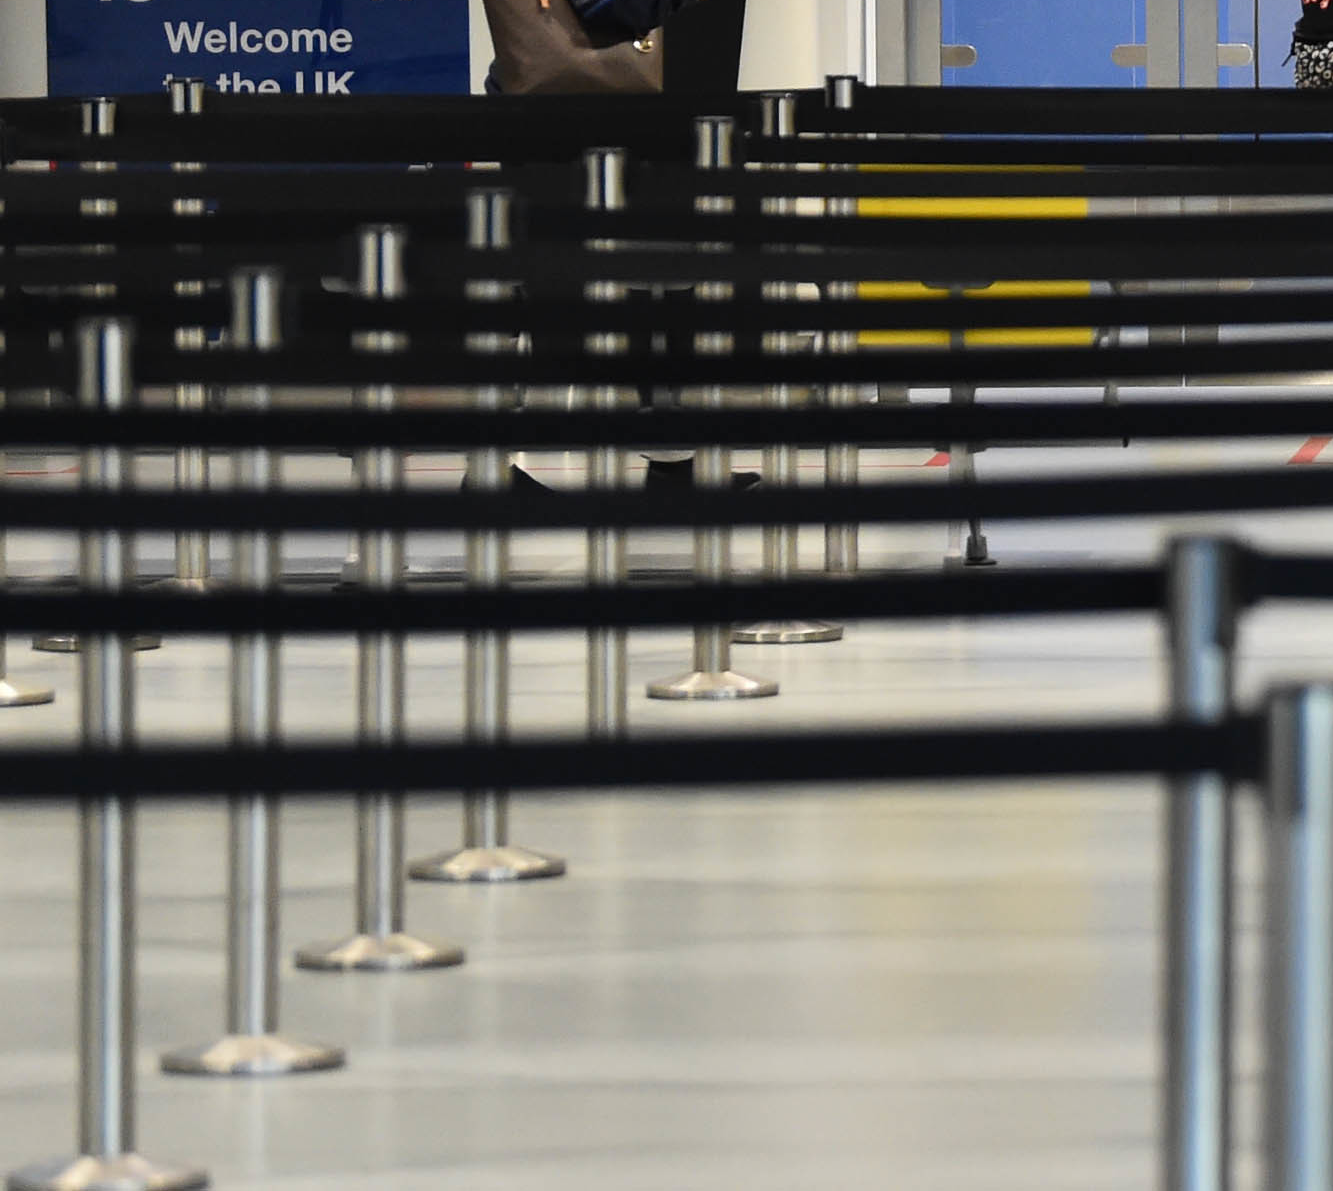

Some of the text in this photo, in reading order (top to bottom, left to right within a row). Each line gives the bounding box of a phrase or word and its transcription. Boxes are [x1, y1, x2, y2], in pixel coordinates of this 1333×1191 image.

[164, 21, 353, 54] Welcome
[215, 71, 281, 94] the
[295, 70, 355, 94] UK
